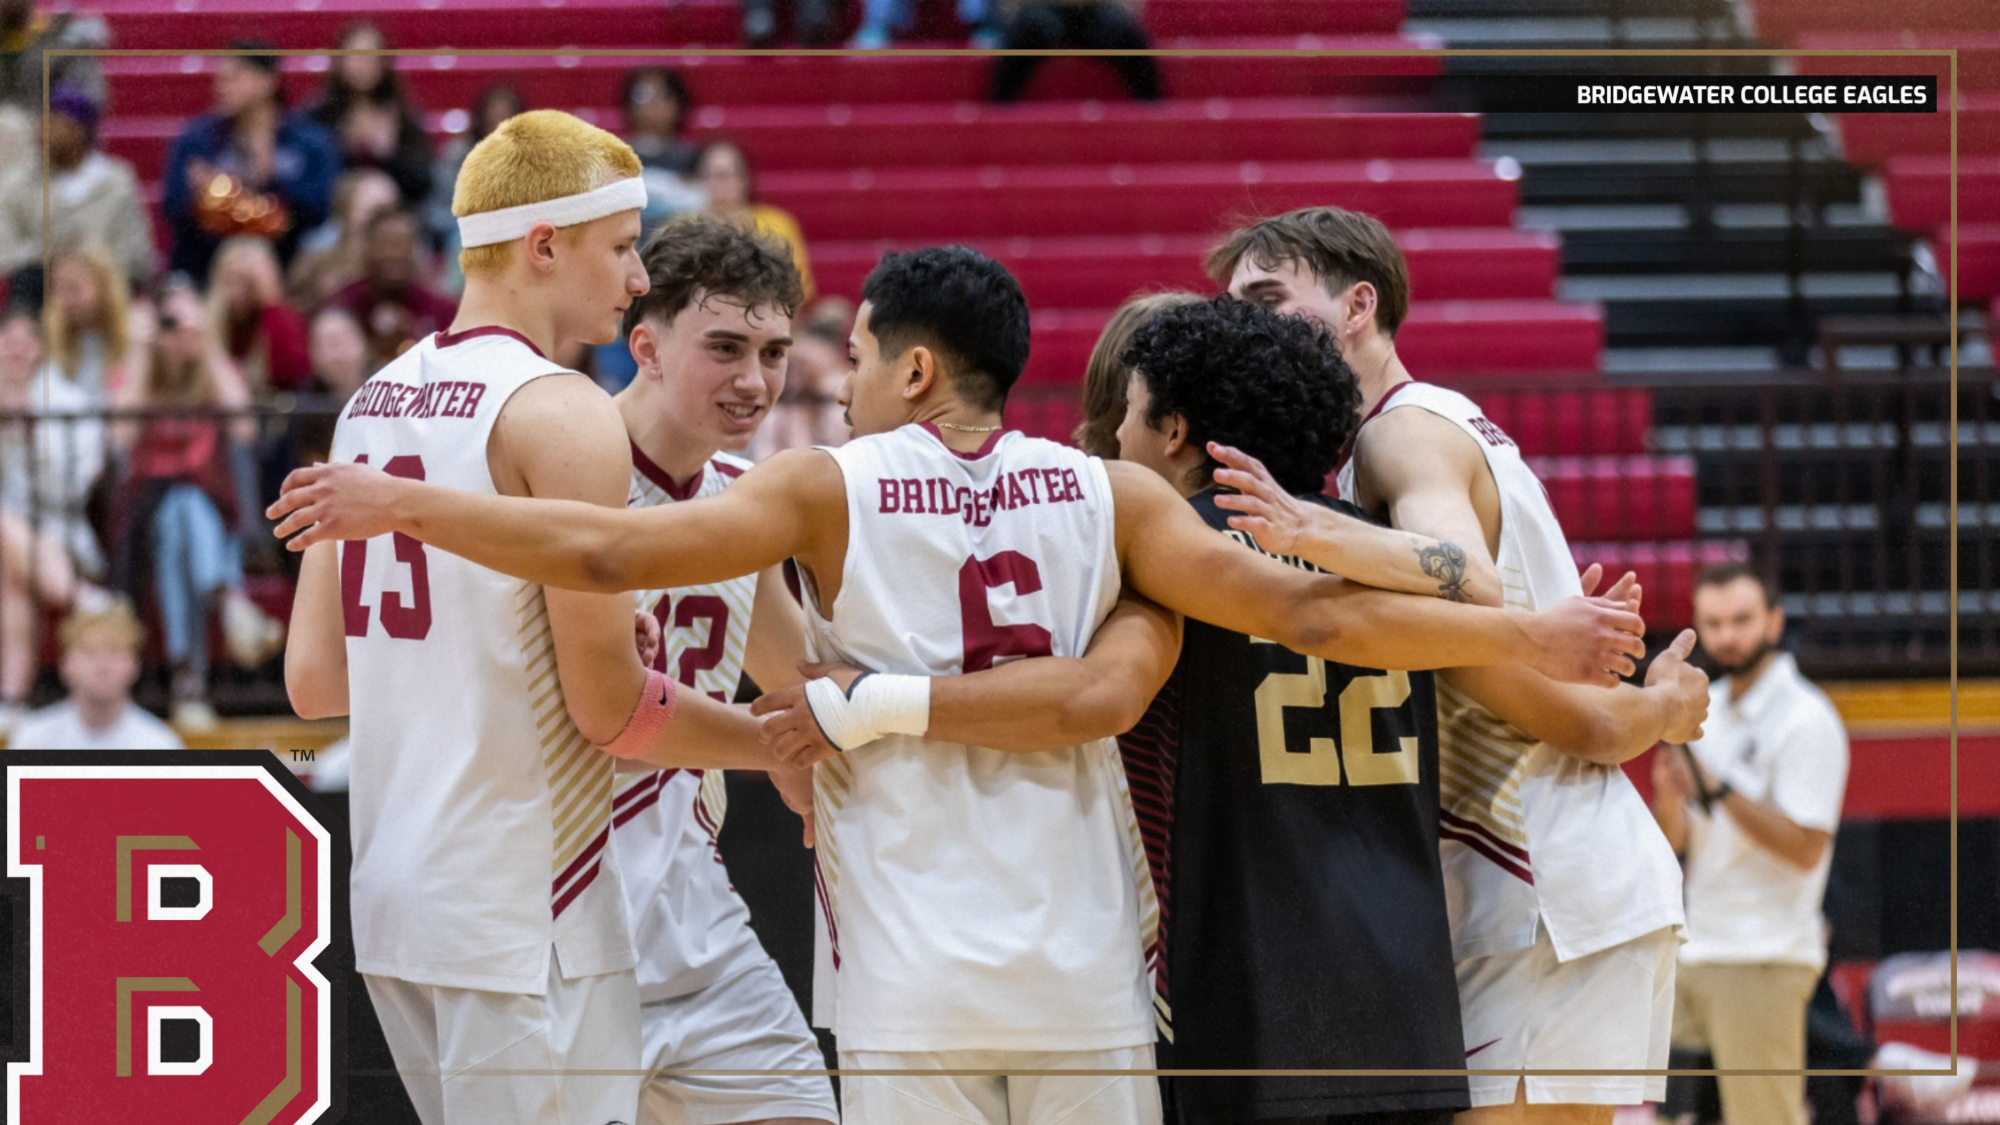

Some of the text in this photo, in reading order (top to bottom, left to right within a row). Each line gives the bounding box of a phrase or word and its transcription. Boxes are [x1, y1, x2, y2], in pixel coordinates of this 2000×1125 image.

[341, 454, 432, 640] 13
[959, 550, 1053, 674] 6
[653, 593, 729, 703] 12
[1250, 635, 1420, 786] 22
